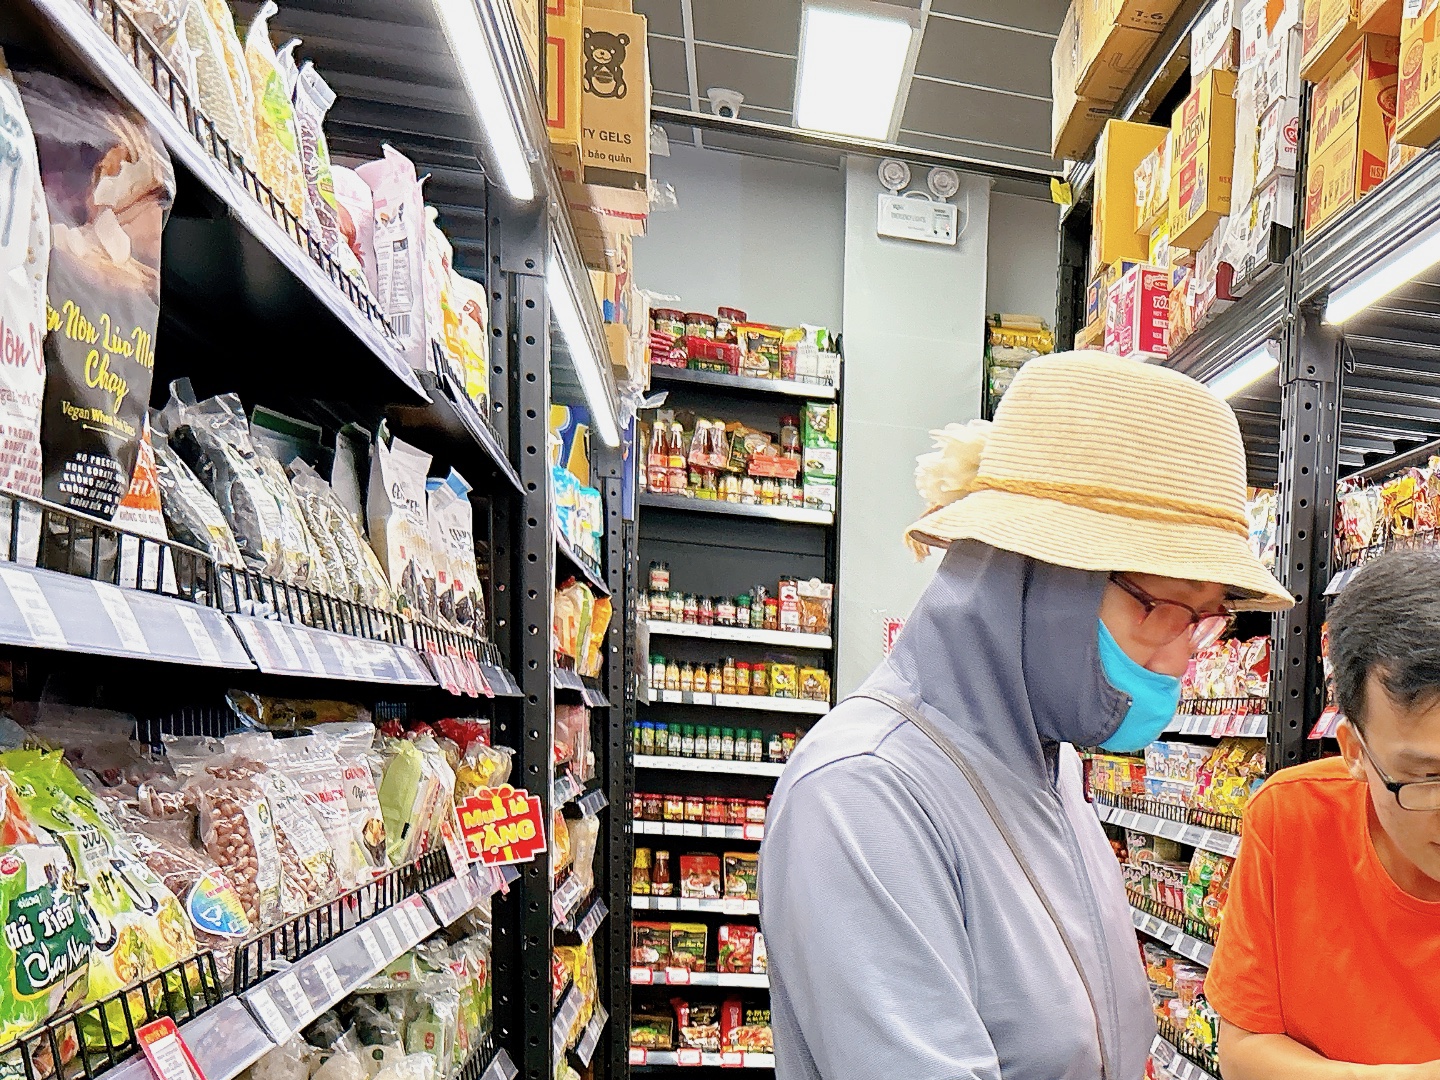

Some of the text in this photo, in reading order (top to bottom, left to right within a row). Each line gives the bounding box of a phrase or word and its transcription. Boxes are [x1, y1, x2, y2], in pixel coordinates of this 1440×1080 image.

[599, 130, 632, 144] GELS
[84, 350, 130, 414] Chay
[62, 401, 90, 420] Vegan
[462, 795, 531, 830] Mua là
[467, 818, 537, 857] TẶNG
[4, 914, 36, 950] Hủ
